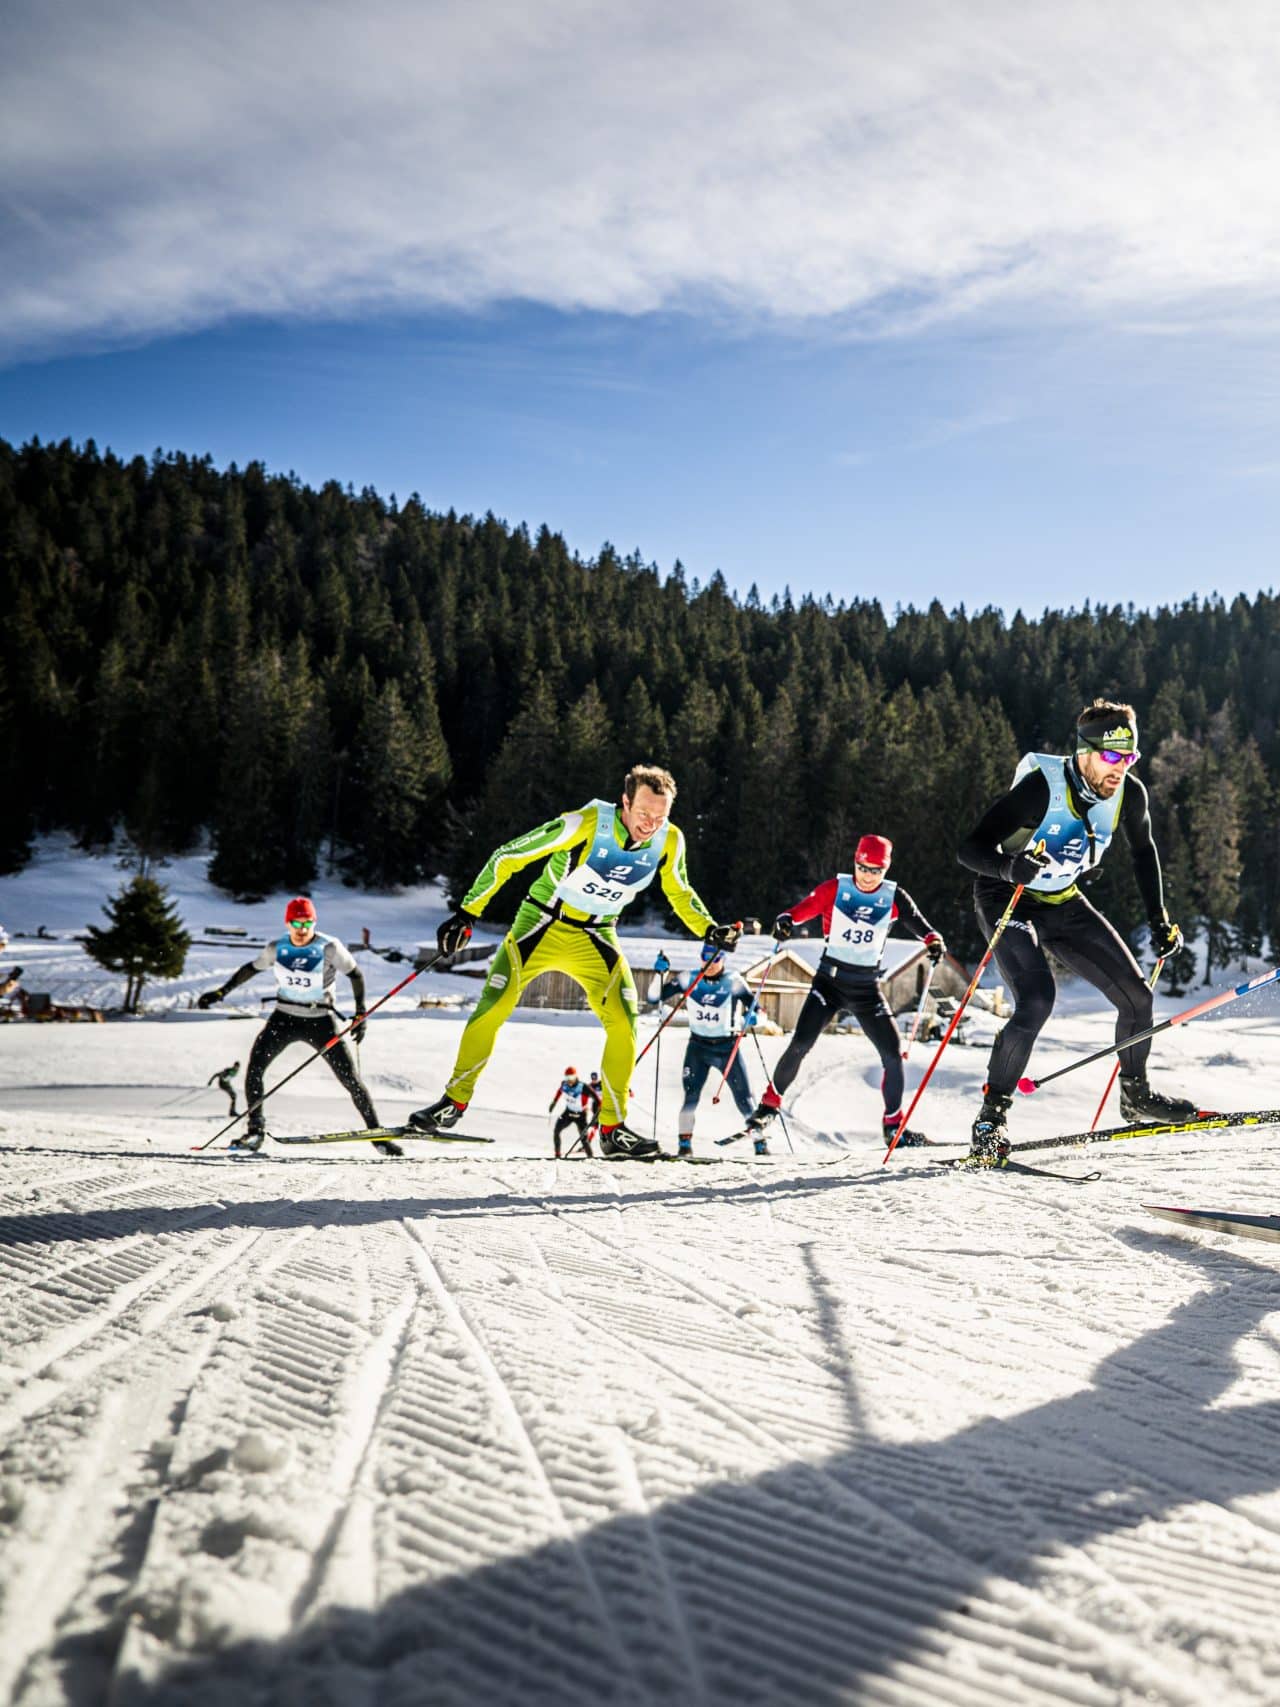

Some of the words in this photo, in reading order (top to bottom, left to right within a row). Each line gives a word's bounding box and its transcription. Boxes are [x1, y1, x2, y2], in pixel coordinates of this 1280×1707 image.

[582, 882, 623, 902] 529
[842, 928, 874, 944] 438
[286, 976, 311, 987] 323
[696, 1010, 720, 1022] 344
[1111, 1119, 1230, 1141] FISCHER
